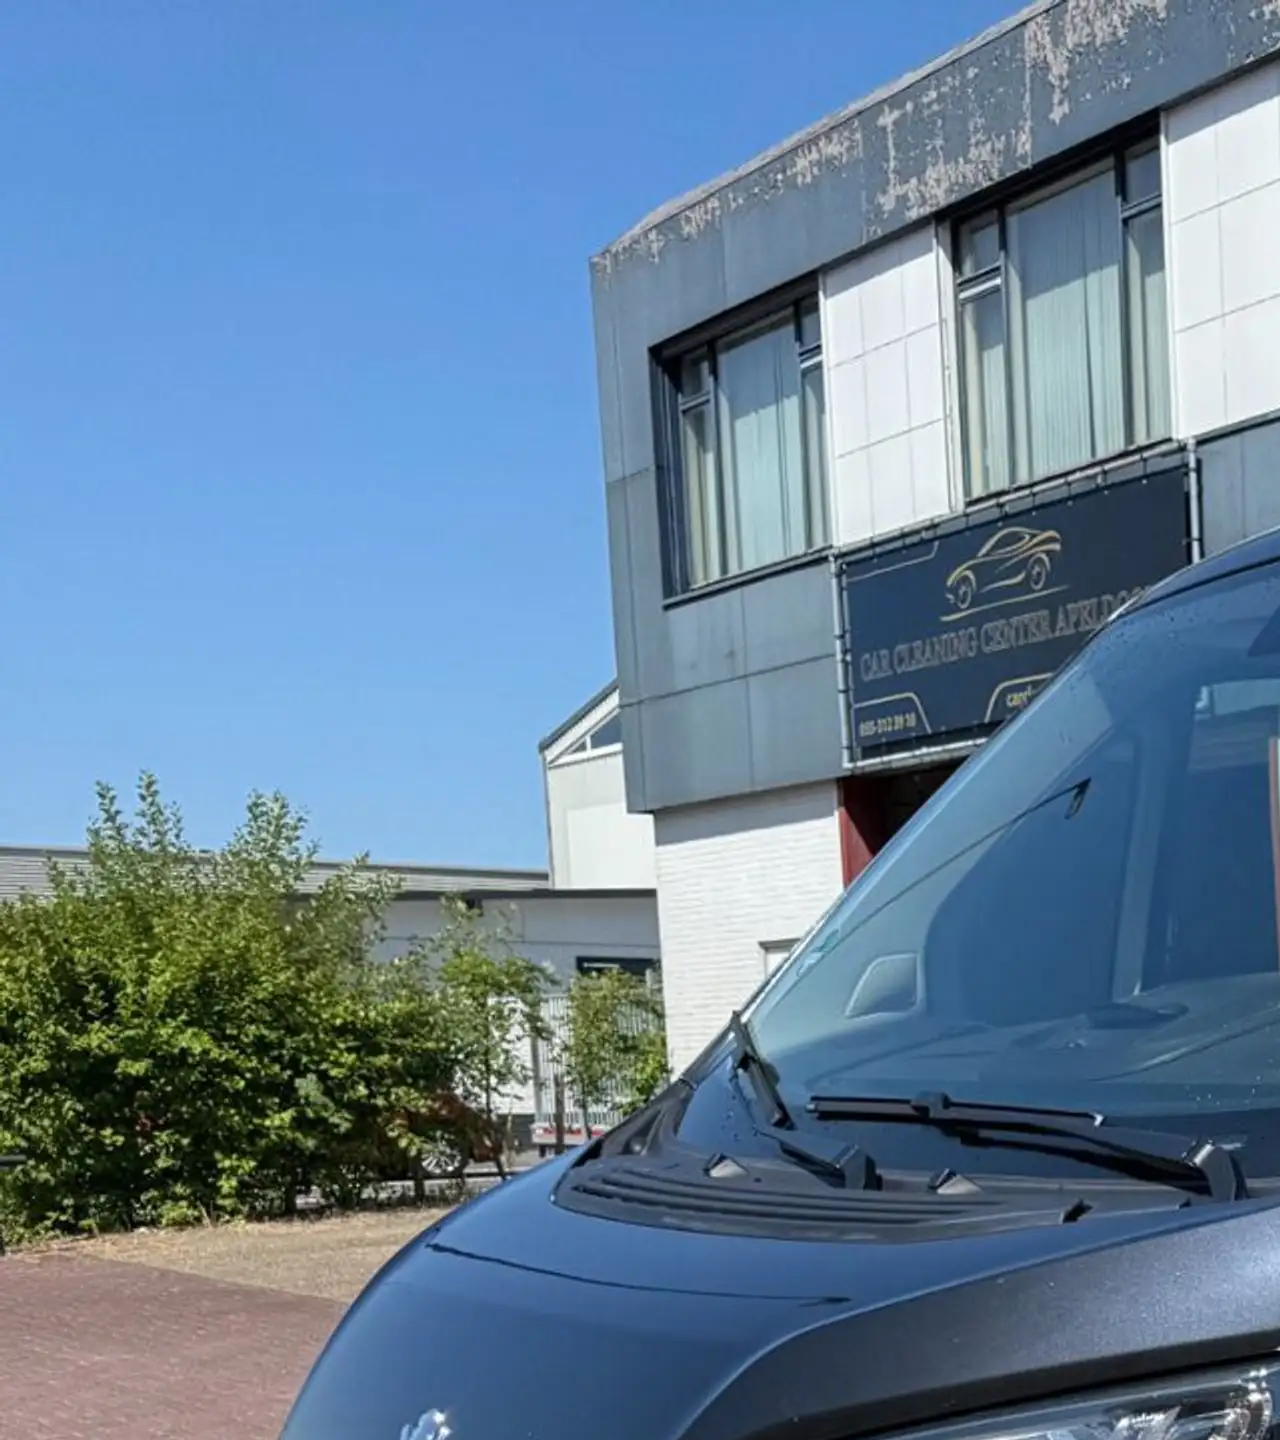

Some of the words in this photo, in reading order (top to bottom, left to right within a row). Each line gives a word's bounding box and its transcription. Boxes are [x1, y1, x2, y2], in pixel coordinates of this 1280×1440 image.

[861, 649, 893, 681] CAR
[894, 626, 978, 675] CLEANING
[980, 609, 1053, 654] CENTER
